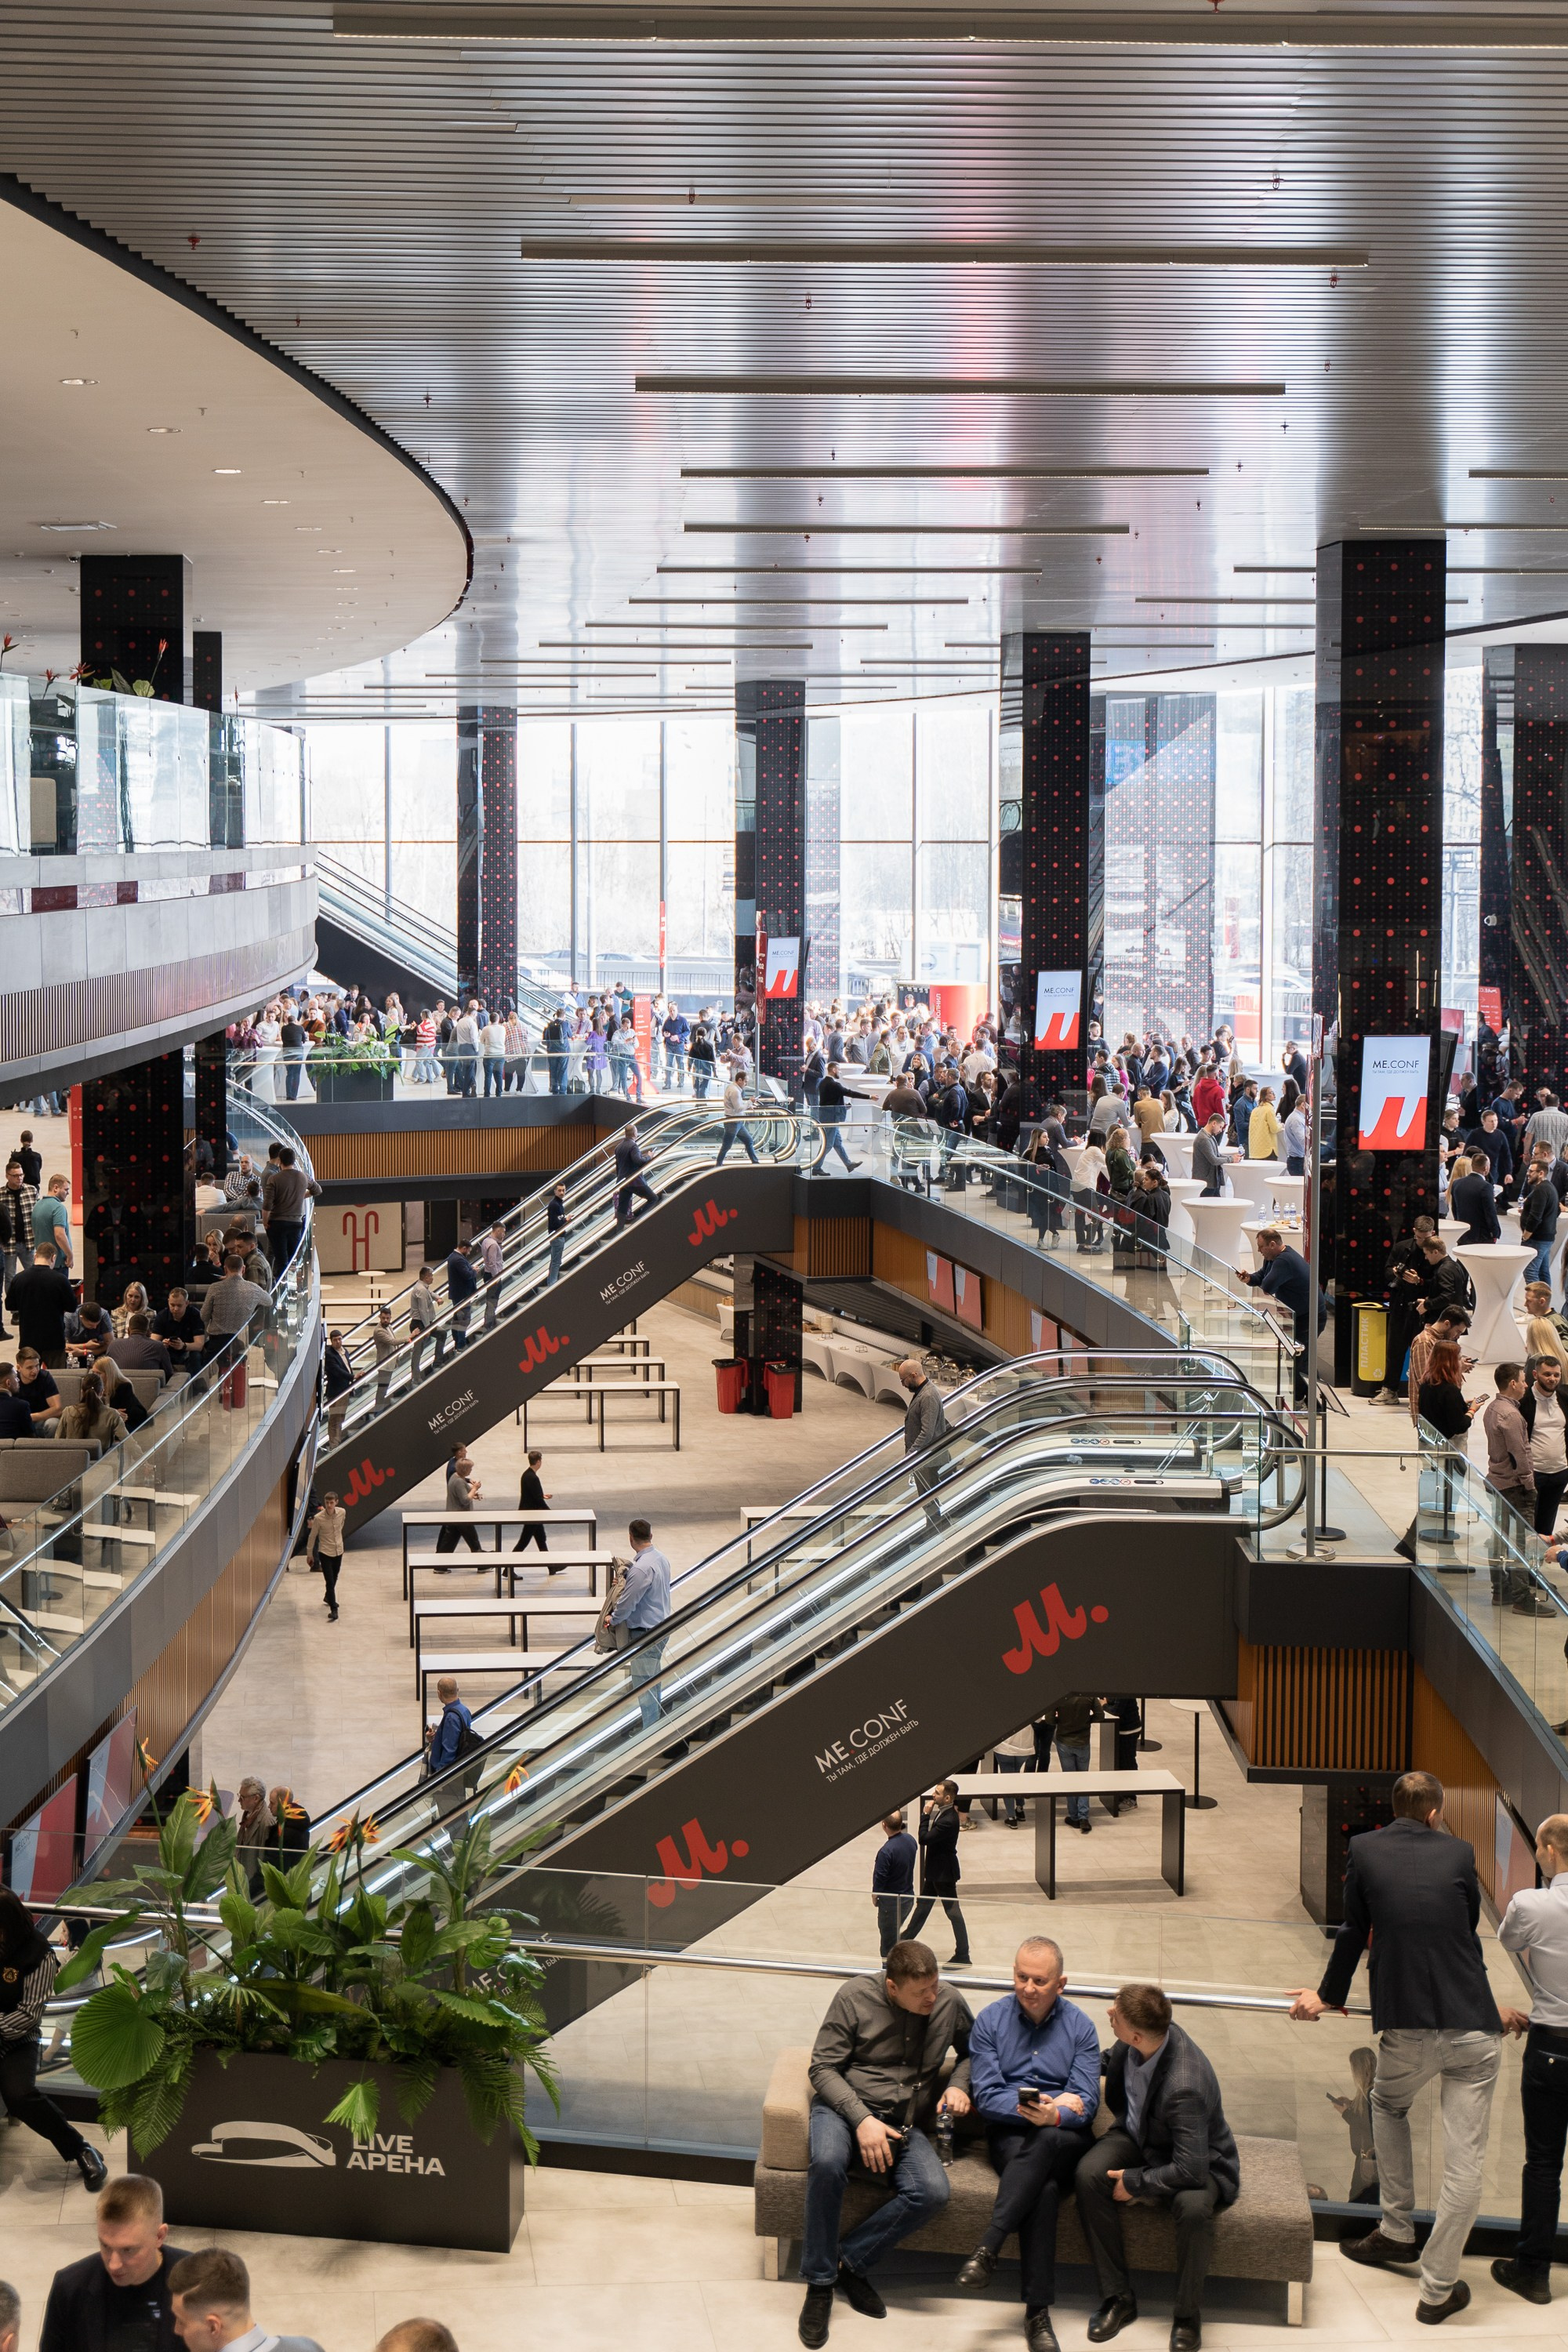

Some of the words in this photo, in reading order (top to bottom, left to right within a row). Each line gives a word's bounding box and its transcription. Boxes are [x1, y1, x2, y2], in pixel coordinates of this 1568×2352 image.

[1372, 1060, 1420, 1069] ME.CONF
[1360, 1316, 1369, 1368] ПЛАСТИК
[815, 1698, 908, 1773] ME.CONF
[826, 1772, 838, 1783] ТЫ
[836, 1762, 856, 1776] ТАМ,
[854, 1751, 869, 1765] ГДЕ
[867, 1730, 901, 1757] ДОЛЖЕН
[899, 1719, 919, 1735] БЫТЬ
[353, 2132, 414, 2154] LIVE
[346, 2151, 446, 2176] АРЕНА
